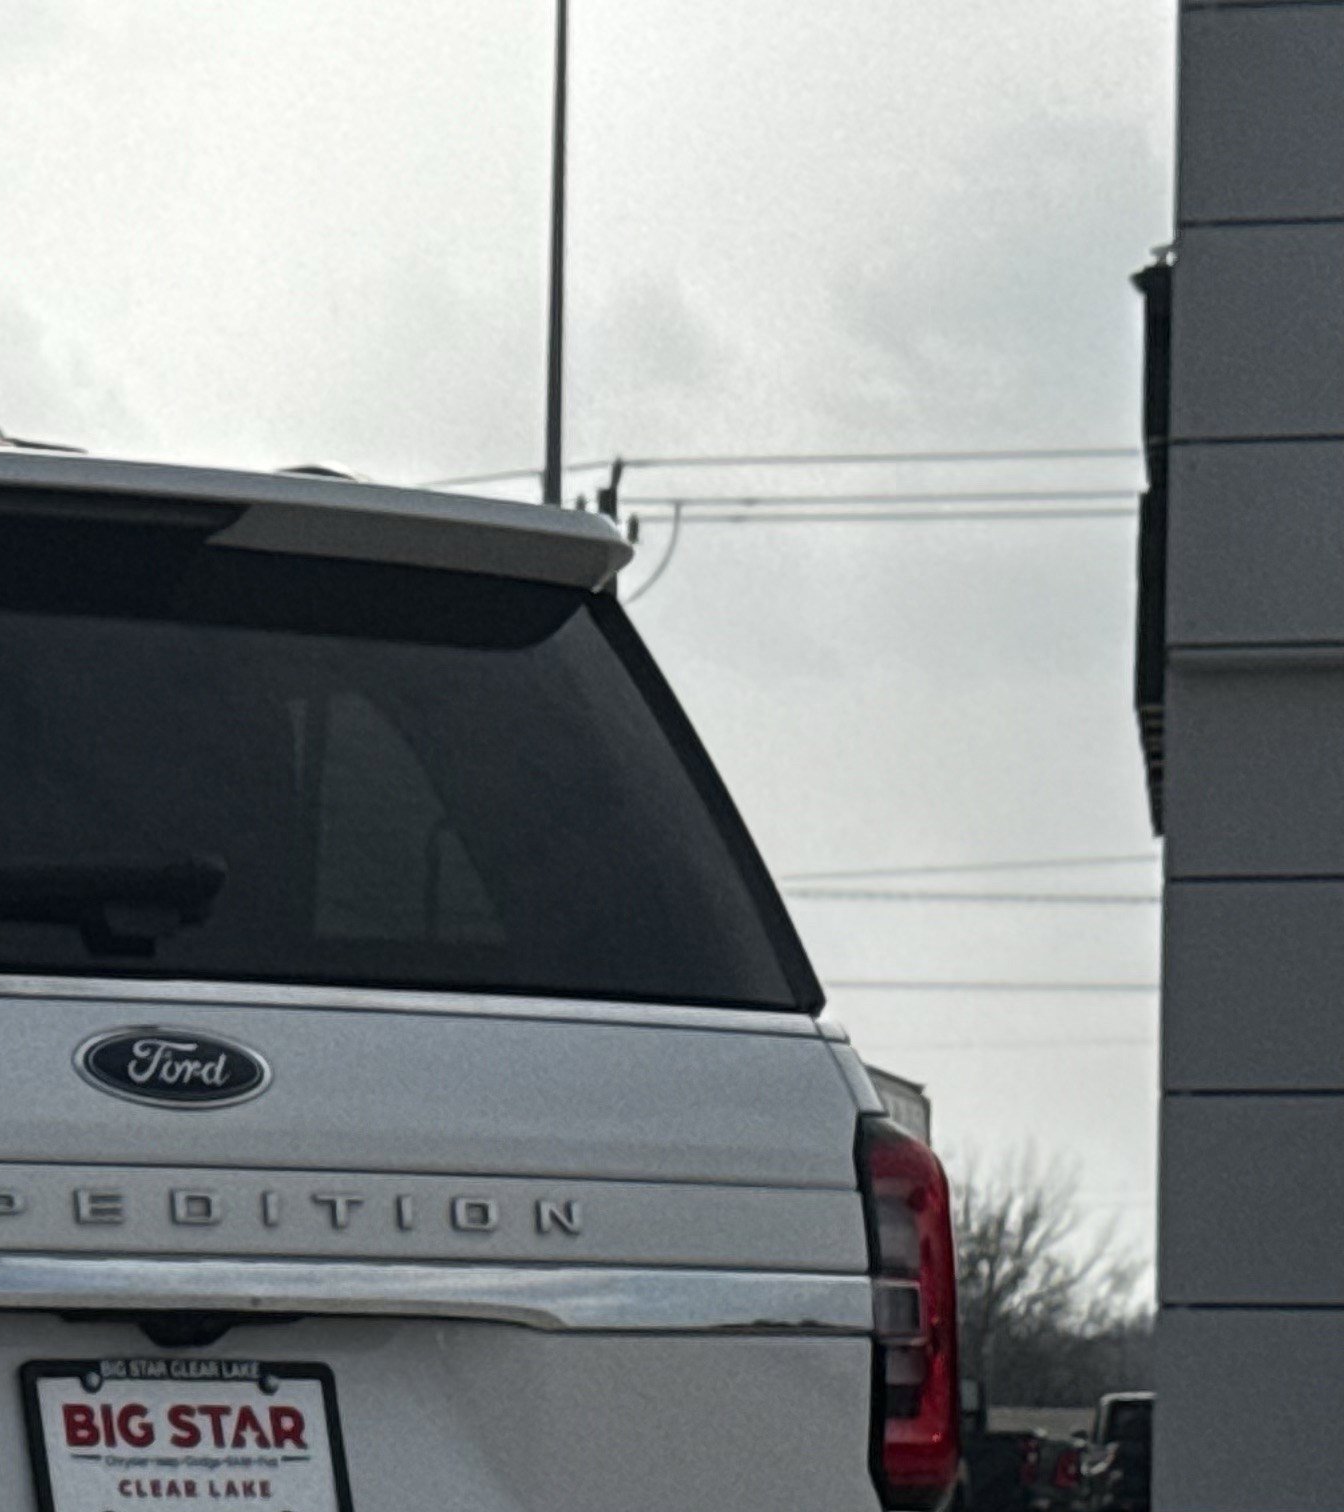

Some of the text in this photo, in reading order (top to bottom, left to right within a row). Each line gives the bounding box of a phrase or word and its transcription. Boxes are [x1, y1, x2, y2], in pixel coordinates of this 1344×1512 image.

[127, 1039, 231, 1087] Ford
[62, 1403, 309, 1450] BIG STAR
[117, 1478, 273, 1499] CLEAR LAKE
